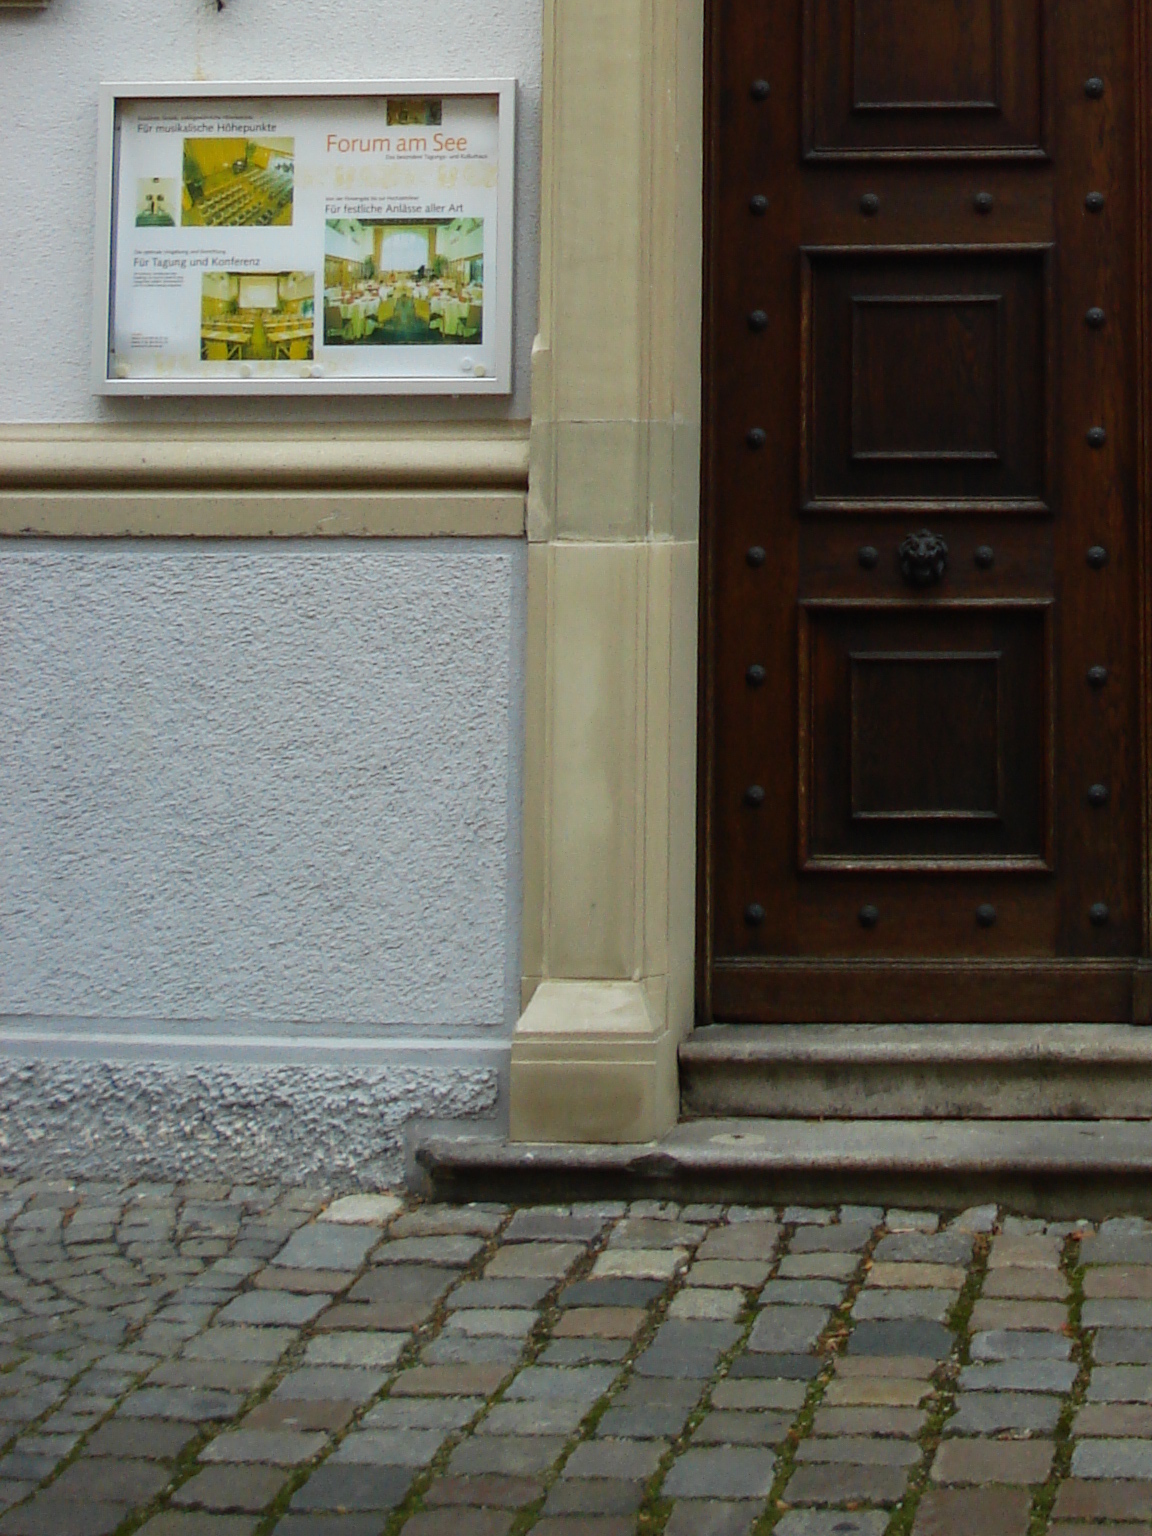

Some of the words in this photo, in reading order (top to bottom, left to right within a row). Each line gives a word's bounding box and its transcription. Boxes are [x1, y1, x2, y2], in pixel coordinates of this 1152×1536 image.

[137, 123, 152, 134] Für
[155, 123, 214, 133] musikalische
[217, 122, 277, 134] Höhepunkte
[326, 134, 391, 152] Forum
[396, 137, 427, 152] am
[432, 133, 468, 152] See
[325, 203, 341, 214] Für
[344, 203, 383, 214] festliche
[385, 203, 422, 213] Anlässe
[425, 203, 445, 213] aller
[448, 203, 464, 213] Art
[133, 257, 149, 267] Für
[152, 256, 187, 269] Tagung
[190, 257, 209, 267] und
[212, 256, 260, 267] Konferenz
